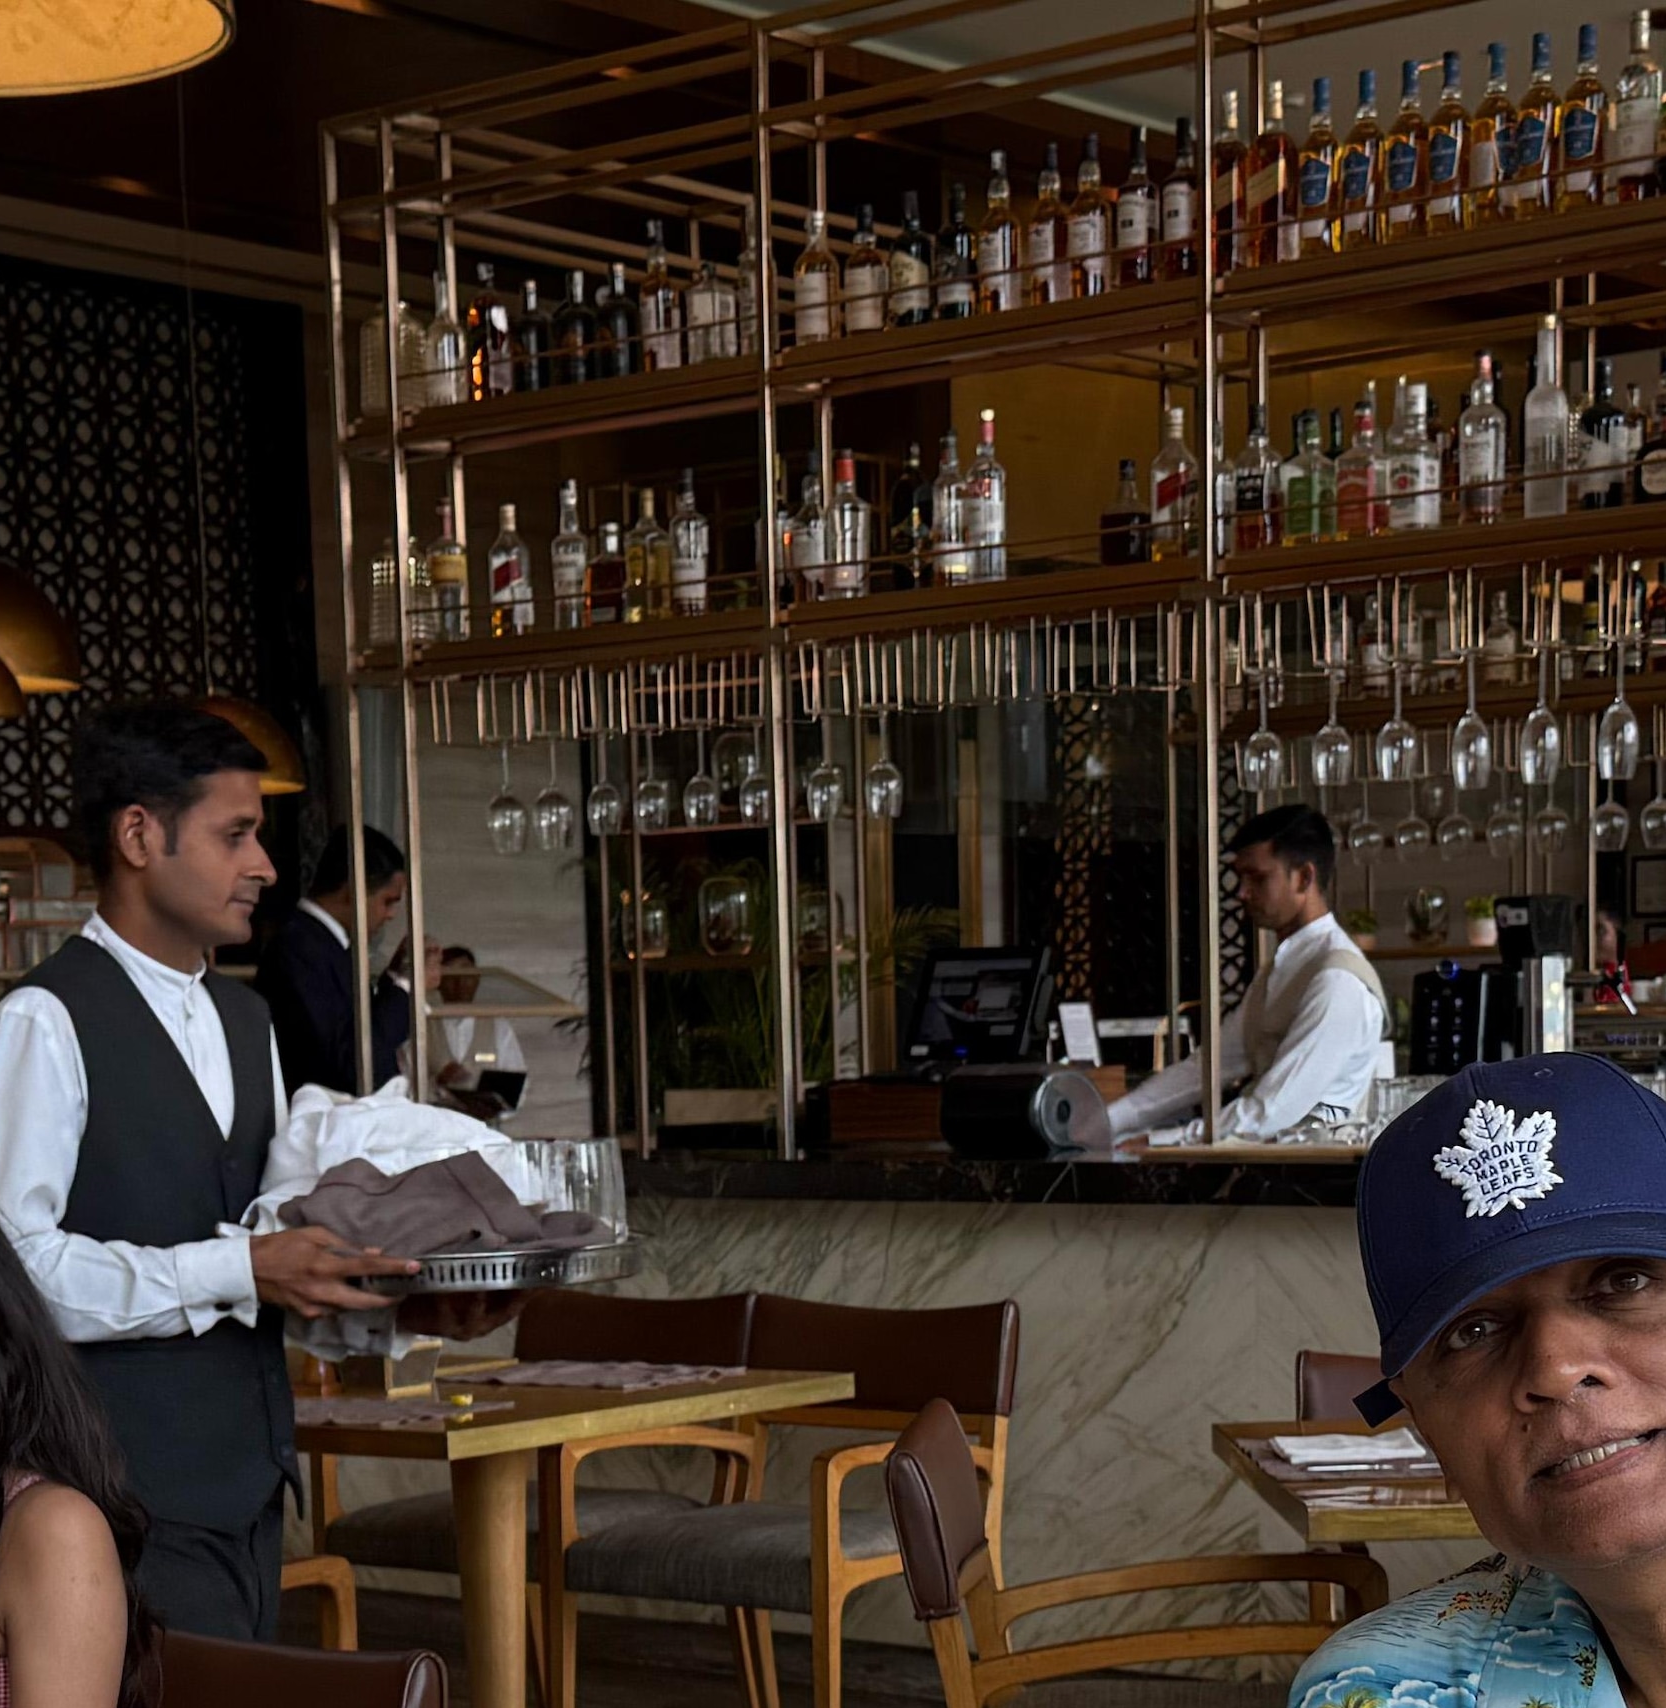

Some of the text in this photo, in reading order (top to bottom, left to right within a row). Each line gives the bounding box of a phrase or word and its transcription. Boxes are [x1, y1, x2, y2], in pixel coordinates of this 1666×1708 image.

[1459, 1140, 1538, 1175] TORONTO
[1475, 1154, 1531, 1182] MAPLE
[1480, 1166, 1535, 1195] LEAFS
